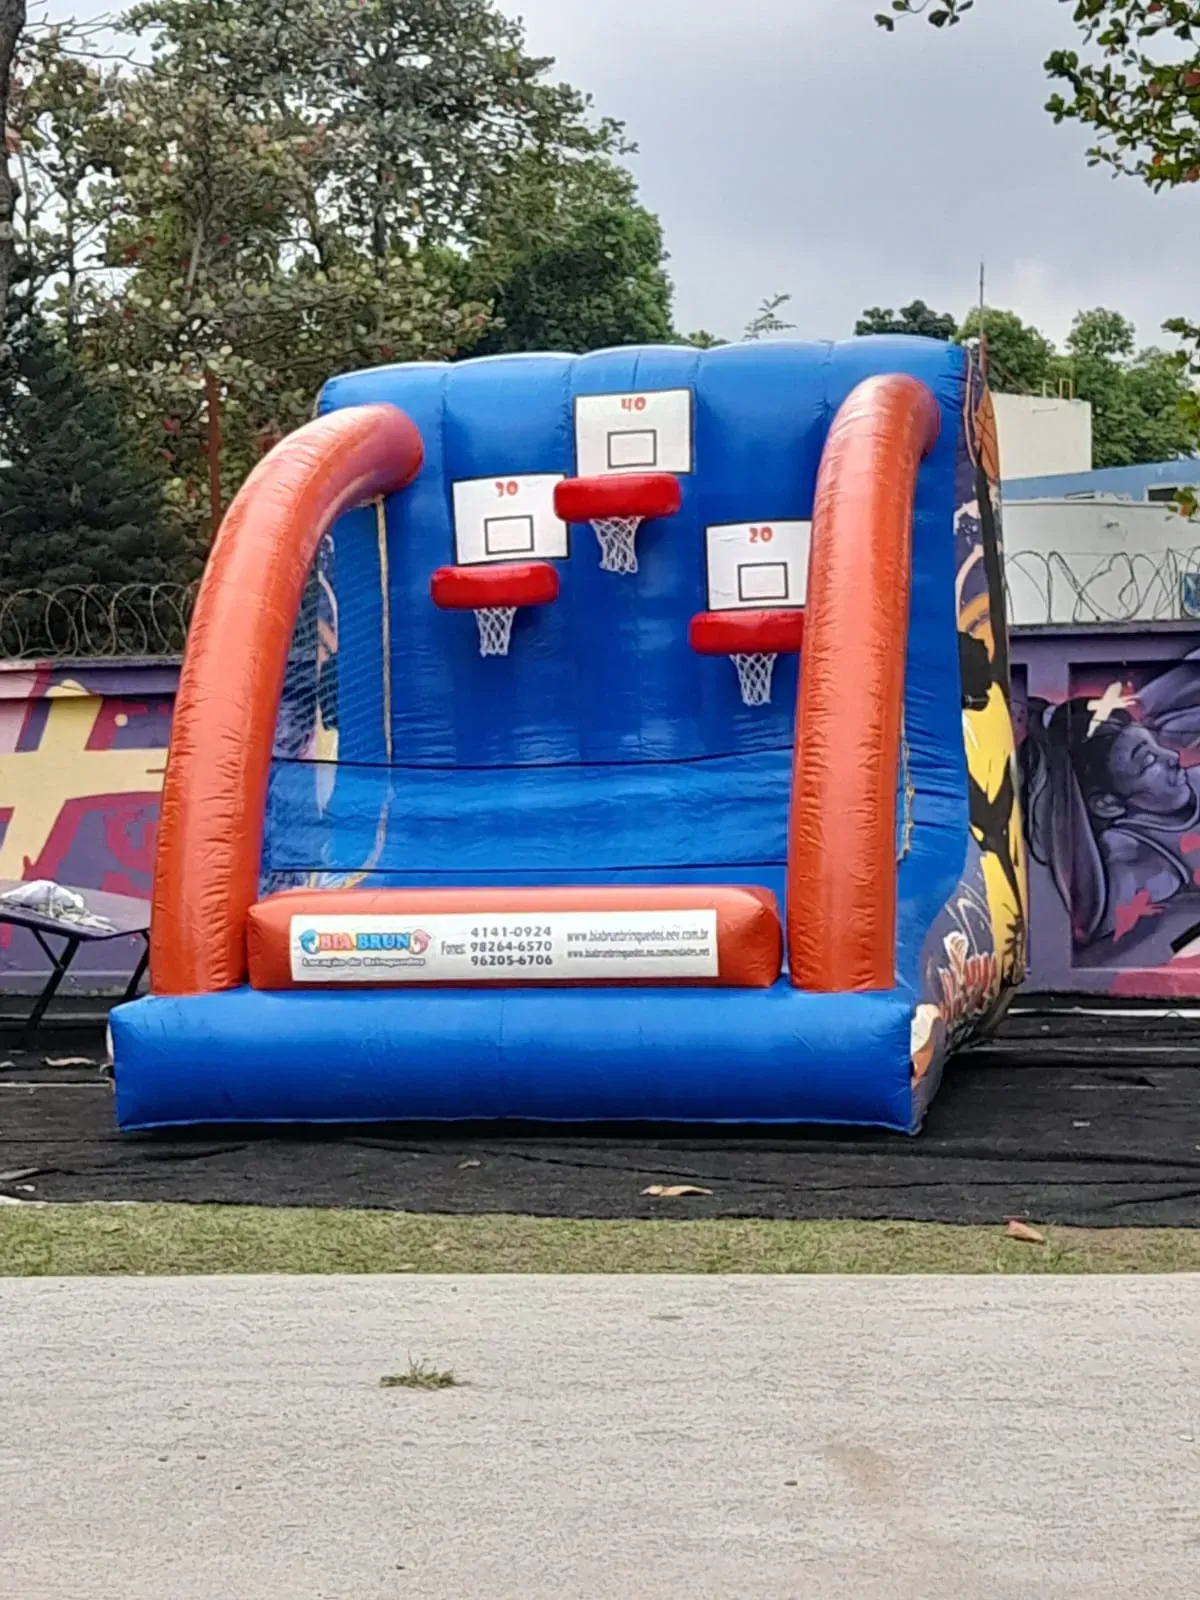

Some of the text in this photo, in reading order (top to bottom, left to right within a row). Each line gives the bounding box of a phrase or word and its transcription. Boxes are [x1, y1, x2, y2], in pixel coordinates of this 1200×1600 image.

[621, 396, 647, 412] 40
[748, 525, 773, 544] 20
[470, 926, 552, 938] 4141-0924
[319, 932, 411, 951] BIA BRUN
[470, 941, 553, 953] 98264-6570
[347, 957, 361, 967] de
[470, 954, 553, 967] 96205-6706
